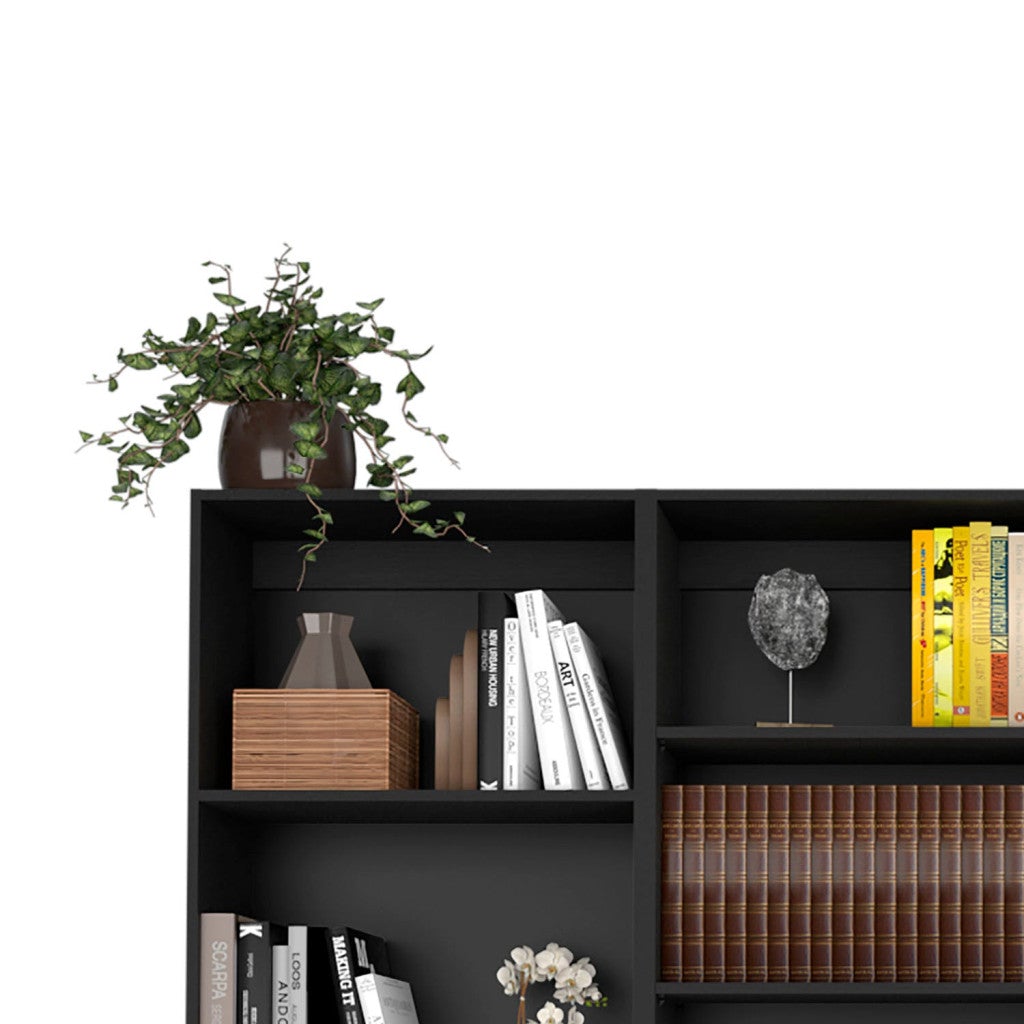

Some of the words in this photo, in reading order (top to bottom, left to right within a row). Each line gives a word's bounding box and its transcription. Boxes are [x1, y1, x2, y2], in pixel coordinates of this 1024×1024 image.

[954, 540, 968, 560] Poet
[972, 533, 989, 581] TRAVELS
[954, 576, 968, 597] Poet
[971, 587, 990, 646] GULLIVER'S
[488, 629, 498, 646] NEW
[488, 647, 498, 673] URBAN
[558, 661, 575, 687] ART
[488, 674, 498, 707] HOUSING
[534, 670, 554, 726] BORDEAUX
[582, 673, 596, 707] Gardens
[592, 708, 600, 717] in
[594, 717, 608, 746] France
[211, 941, 227, 1000] SCARPA
[292, 952, 301, 990] LOOS
[332, 936, 352, 991] MAKING
[340, 992, 355, 1006] IT
